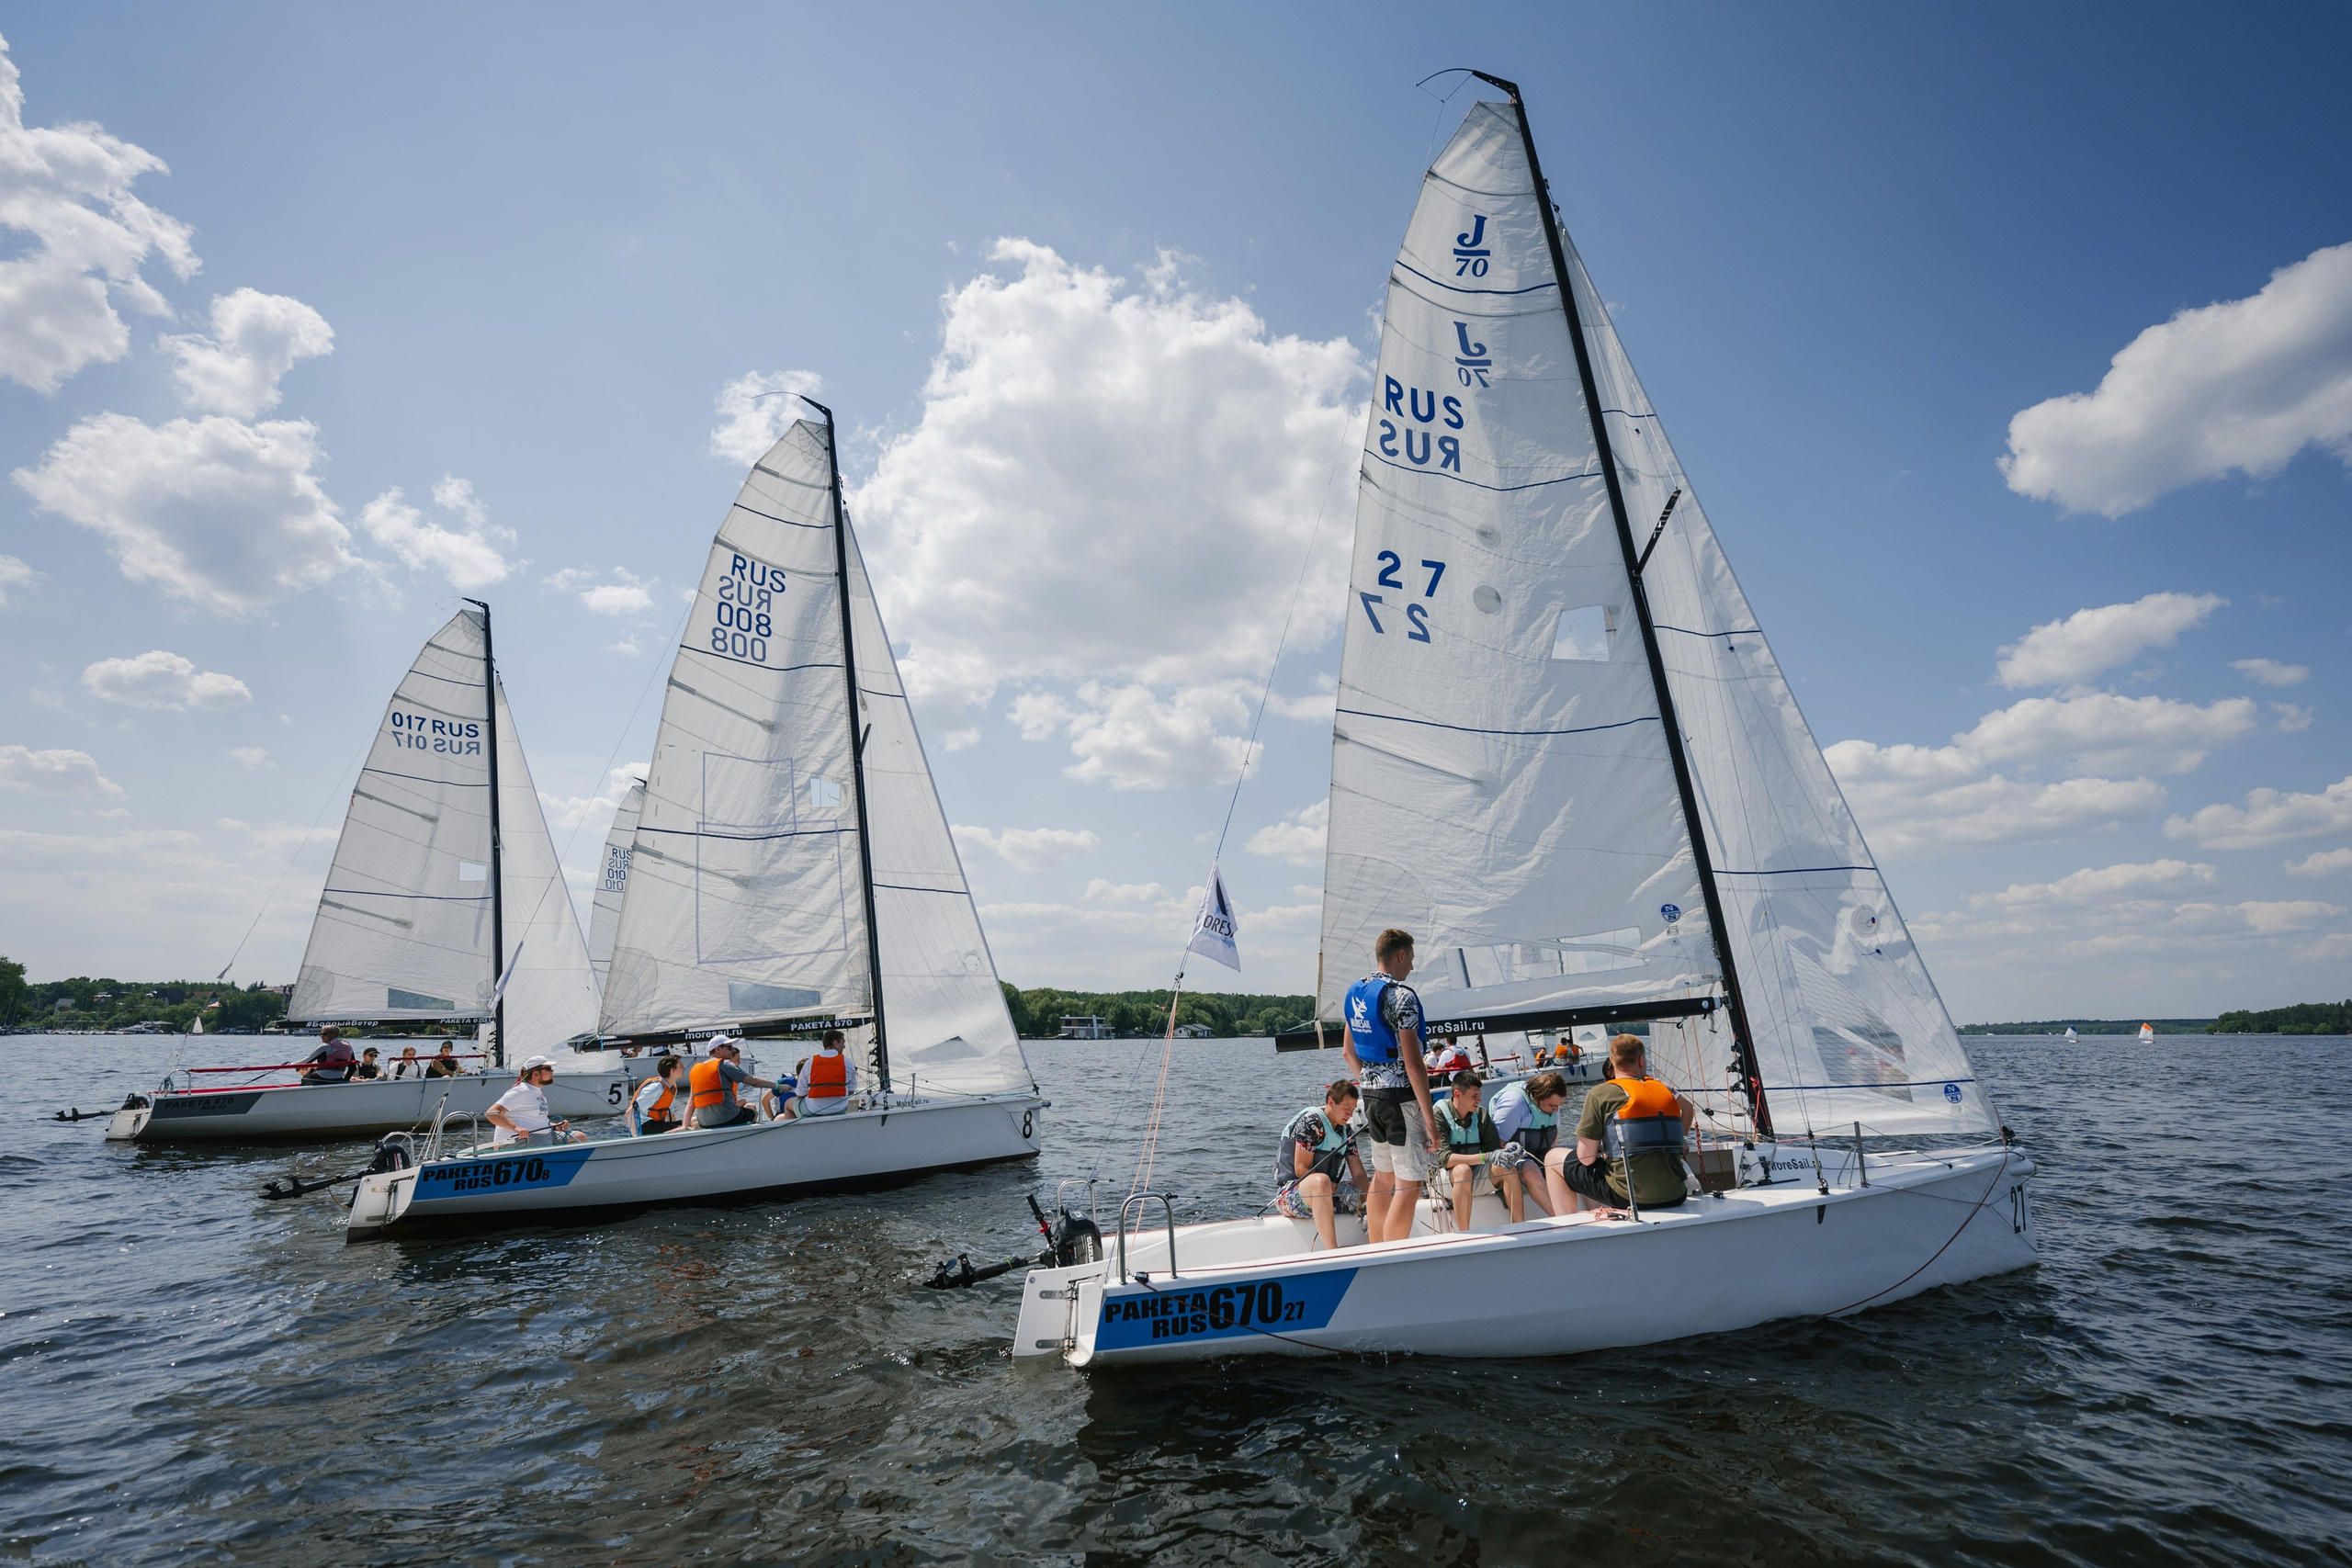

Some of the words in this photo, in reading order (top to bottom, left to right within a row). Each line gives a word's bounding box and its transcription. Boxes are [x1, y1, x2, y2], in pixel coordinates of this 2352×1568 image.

[1456, 214, 1487, 248] J
[1455, 257, 1489, 277] 70
[1385, 373, 1464, 430] RUS
[730, 553, 786, 593] RUS
[717, 601, 772, 638] 008
[391, 711, 427, 732] 017
[431, 718, 480, 739] RUS
[612, 847, 633, 860] RUS
[607, 868, 627, 881] 010
[790, 1021, 831, 1031] РАКЕТА
[834, 1019, 853, 1027] 670
[1425, 1020, 1486, 1034] oreSail.ru
[214, 1096, 234, 1106] 670
[607, 1083, 622, 1105] 5
[1022, 1110, 1033, 1140] 8
[454, 1175, 492, 1191] RUS
[492, 1157, 544, 1186] 670
[541, 1168, 550, 1181] 8
[1086, 1235, 1094, 1264] SUZUK
[1208, 1281, 1283, 1330] 670
[1283, 1301, 1306, 1322] 27
[1152, 1314, 1208, 1339] RUS
